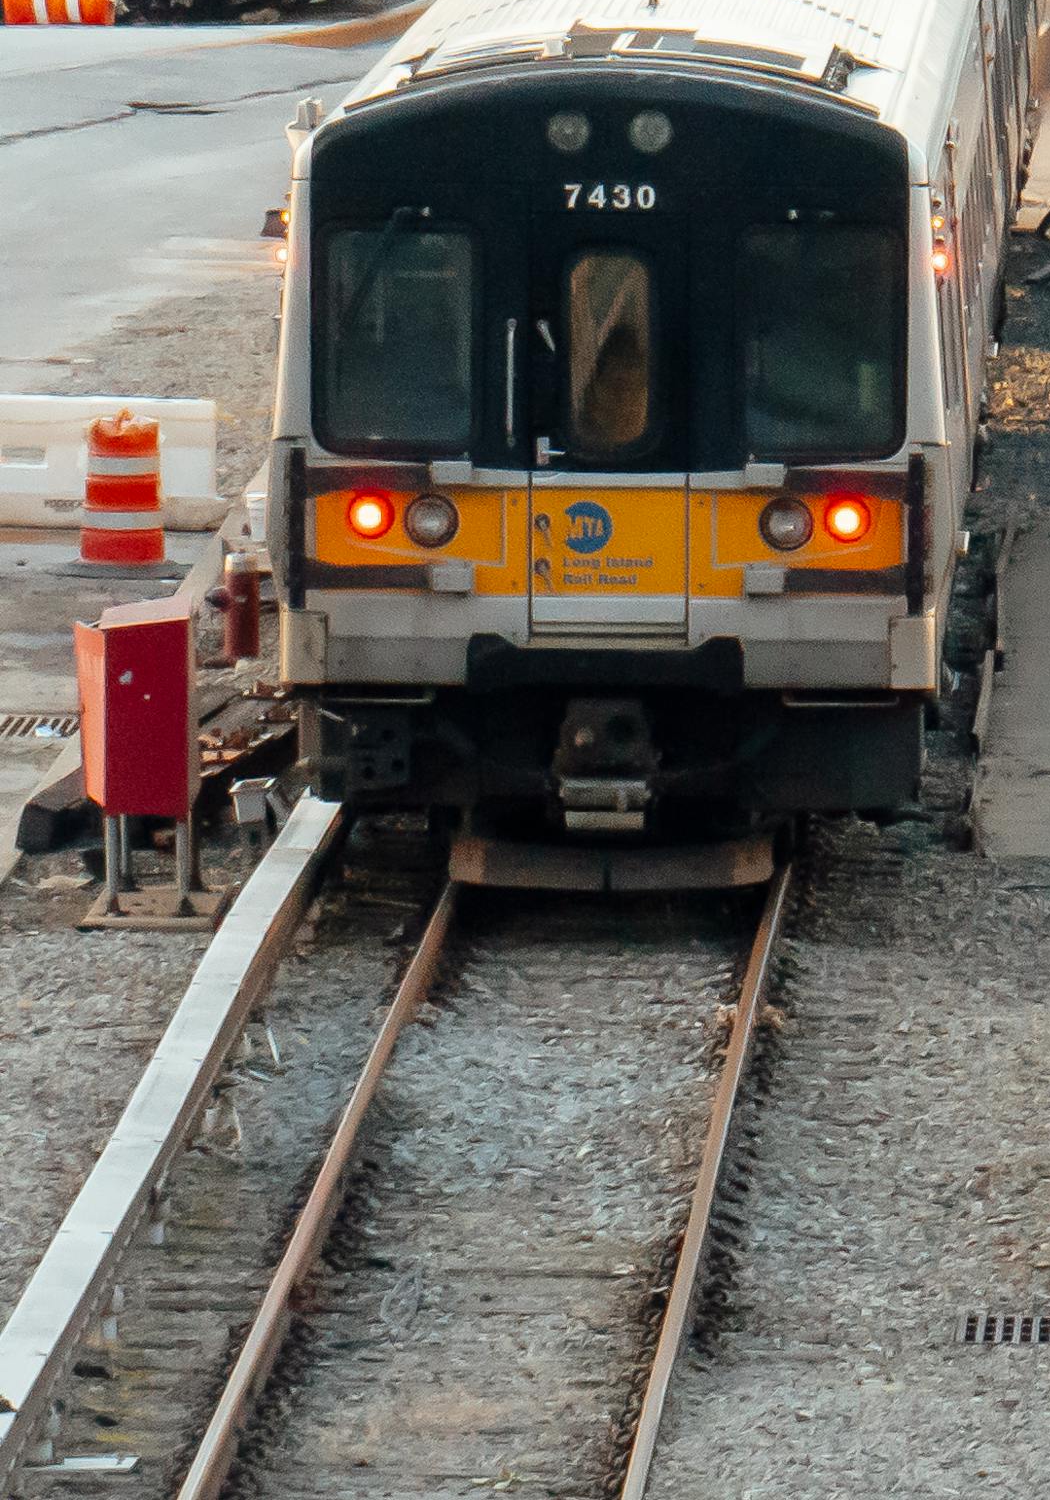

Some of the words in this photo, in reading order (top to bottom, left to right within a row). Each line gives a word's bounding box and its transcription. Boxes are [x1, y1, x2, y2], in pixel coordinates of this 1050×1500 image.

[564, 184, 656, 209] 7430
[563, 557, 600, 569] Long
[606, 556, 653, 568] Island
[563, 574, 593, 584] Rail
[599, 574, 637, 585] Road
